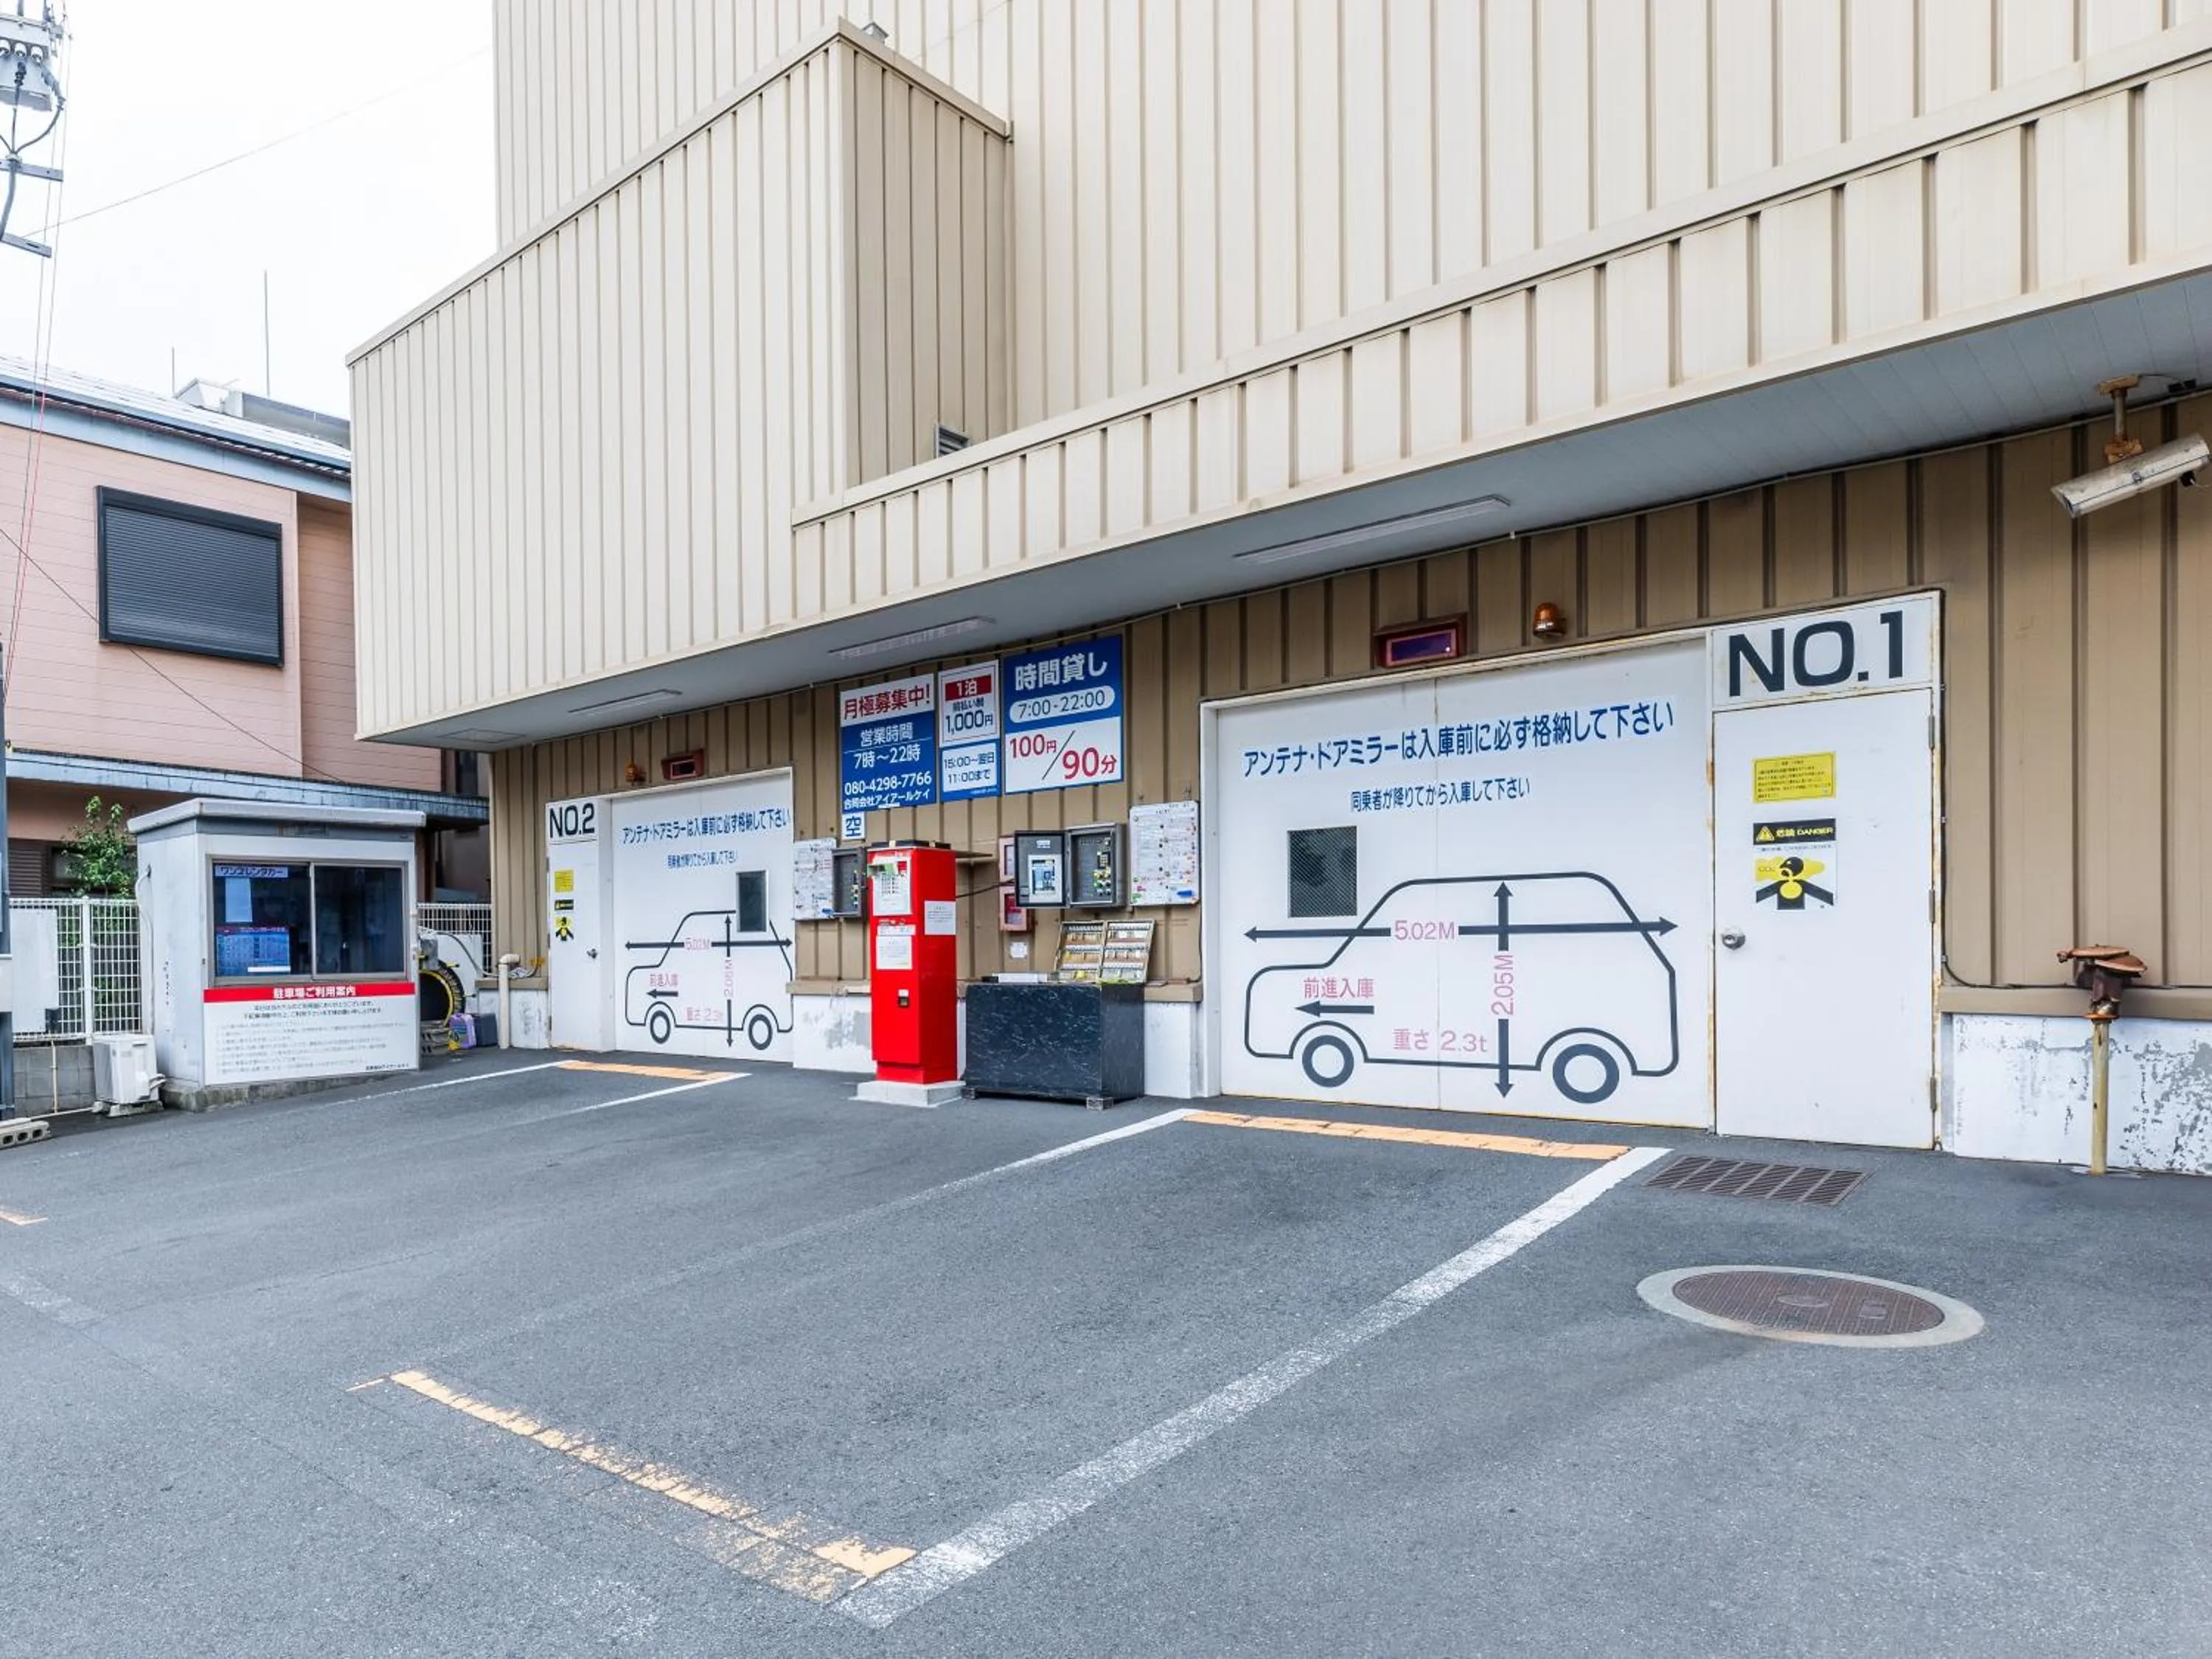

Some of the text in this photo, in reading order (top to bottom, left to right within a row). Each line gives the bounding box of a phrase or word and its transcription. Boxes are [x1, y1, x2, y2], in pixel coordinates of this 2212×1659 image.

[1729, 610, 1903, 697] NO.1
[1015, 652, 1108, 691] 時間貸し
[956, 680, 978, 697] 1泊
[844, 684, 931, 720] 月極募集中!
[860, 722, 914, 747] 営業時間
[945, 709, 993, 735] 1,000円
[1010, 734, 1057, 759] 100円
[1062, 747, 1117, 779] 90分
[844, 771, 932, 796] 080-4298-7766
[1351, 776, 1531, 812] 同乗者が降りてから入庫して下さい
[549, 802, 595, 838] NO.2
[846, 815, 862, 838] 空
[1797, 827, 1834, 836] DANGER
[1394, 919, 1455, 941] 5.02M
[1302, 977, 1374, 1000] 前進入庫
[1491, 954, 1514, 1016] 2.05M
[1393, 1028, 1488, 1054] 重さ 2.3t
